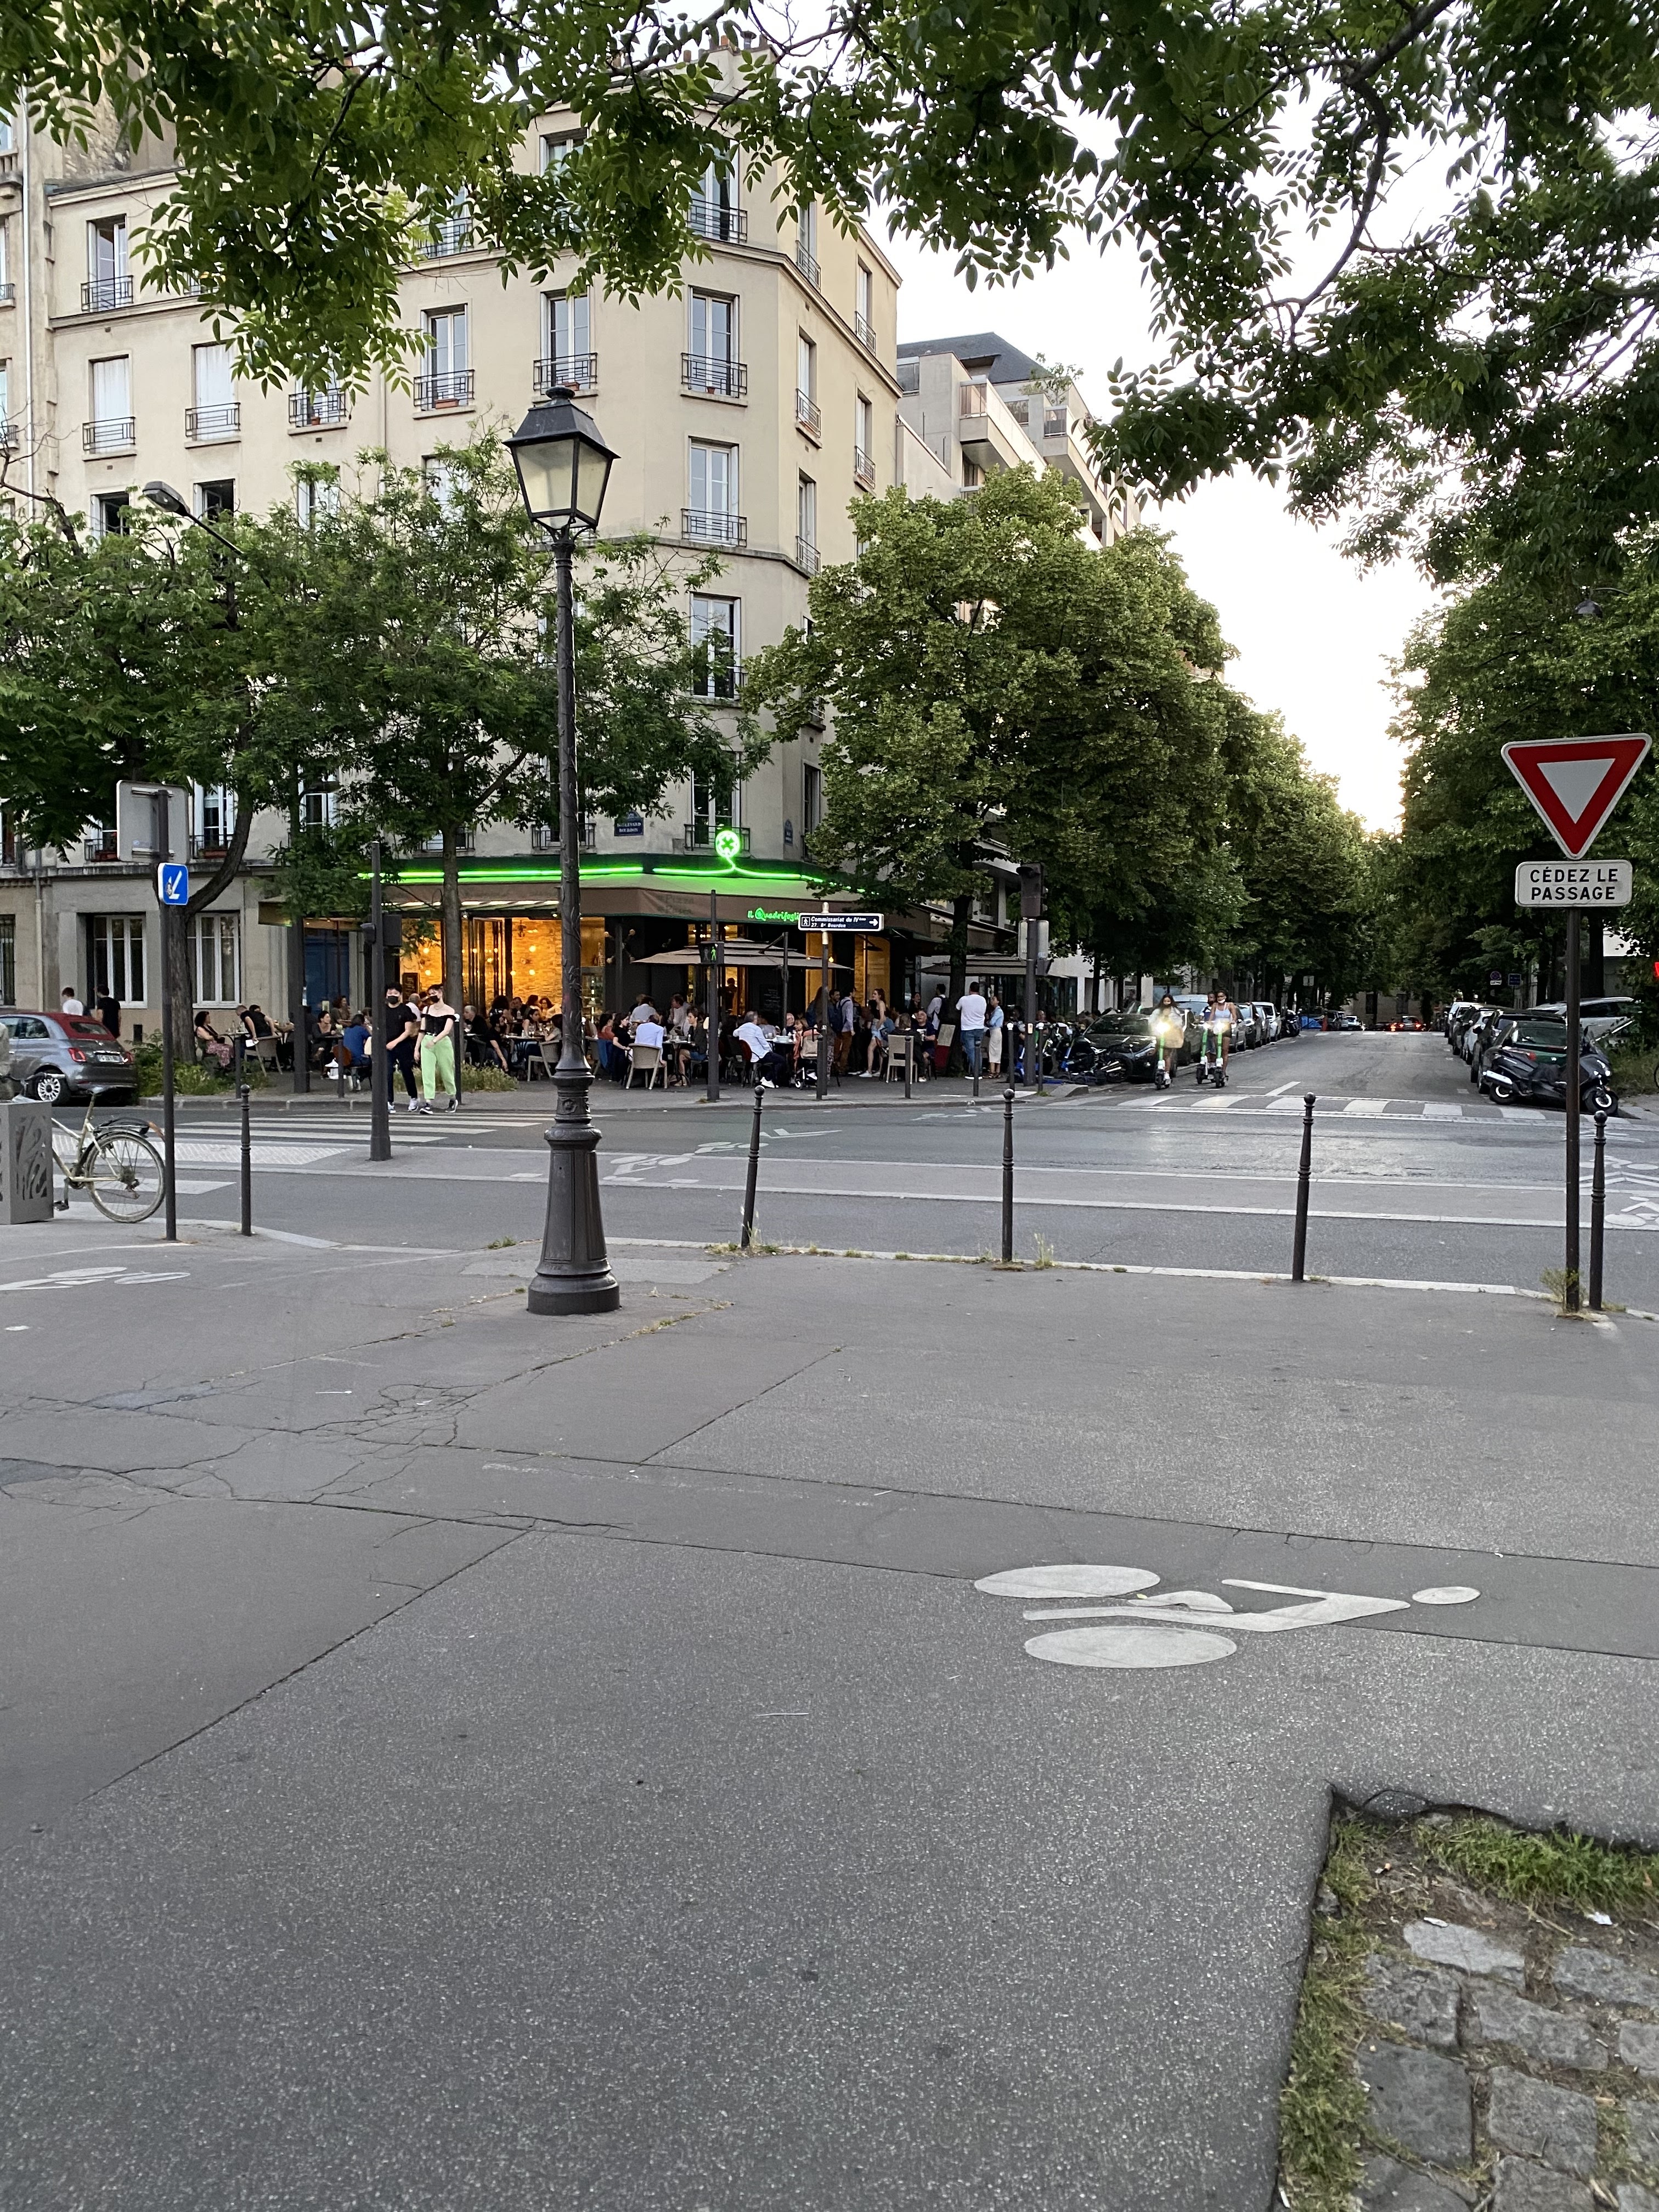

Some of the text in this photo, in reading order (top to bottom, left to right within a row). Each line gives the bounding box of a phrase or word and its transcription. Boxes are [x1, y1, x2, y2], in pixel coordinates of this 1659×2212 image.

[1530, 866, 1618, 883] CÉDEZ LE
[1531, 886, 1615, 900] PASSAGE
[755, 907, 800, 922] Quadrifogli
